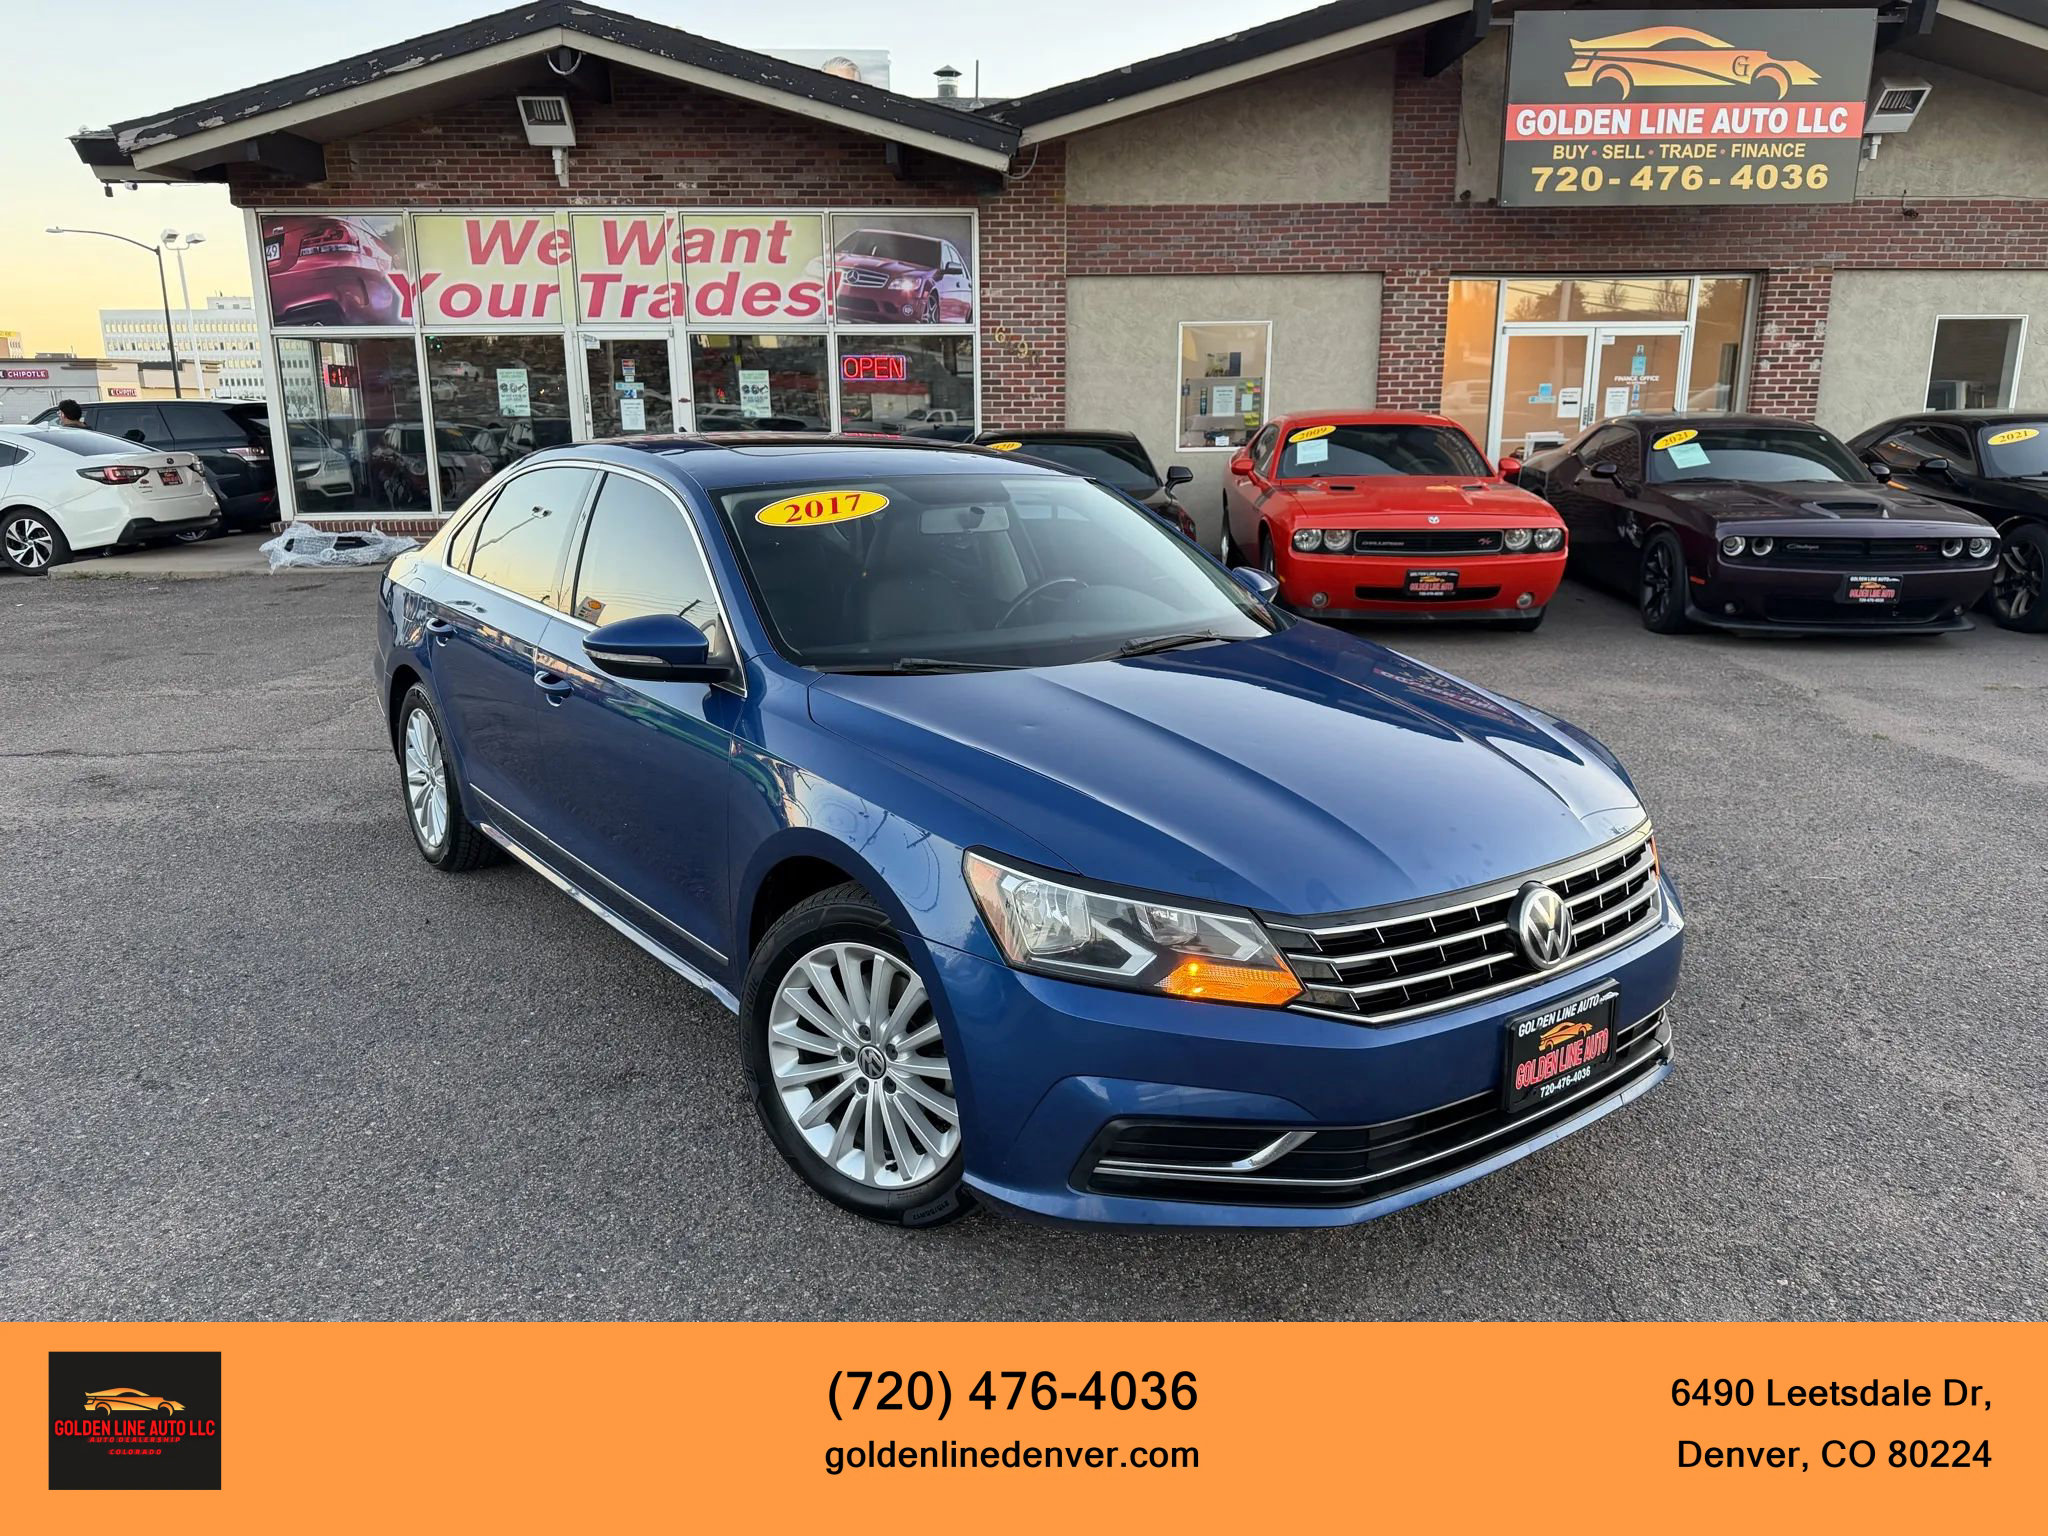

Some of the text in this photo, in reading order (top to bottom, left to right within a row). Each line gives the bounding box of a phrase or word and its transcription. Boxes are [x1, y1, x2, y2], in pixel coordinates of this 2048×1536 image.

[1731, 55, 1750, 77] G
[1515, 106, 1849, 137] GOLDEN LINE AUTO LLC
[1552, 142, 1806, 161] BUY SELL TRADE FINANCE
[465, 218, 793, 266] We Want
[387, 271, 842, 319] Your Trades!
[843, 357, 903, 378] OPEN
[1663, 431, 1689, 447] 2021
[1998, 430, 2029, 443] 2021
[783, 493, 861, 523] 2017
[1518, 993, 1600, 1037] GOLDEN LINE AUTO
[1515, 1027, 1609, 1090] GOLDEN LINE AUTO
[1540, 1066, 1591, 1098] 720-476-4036
